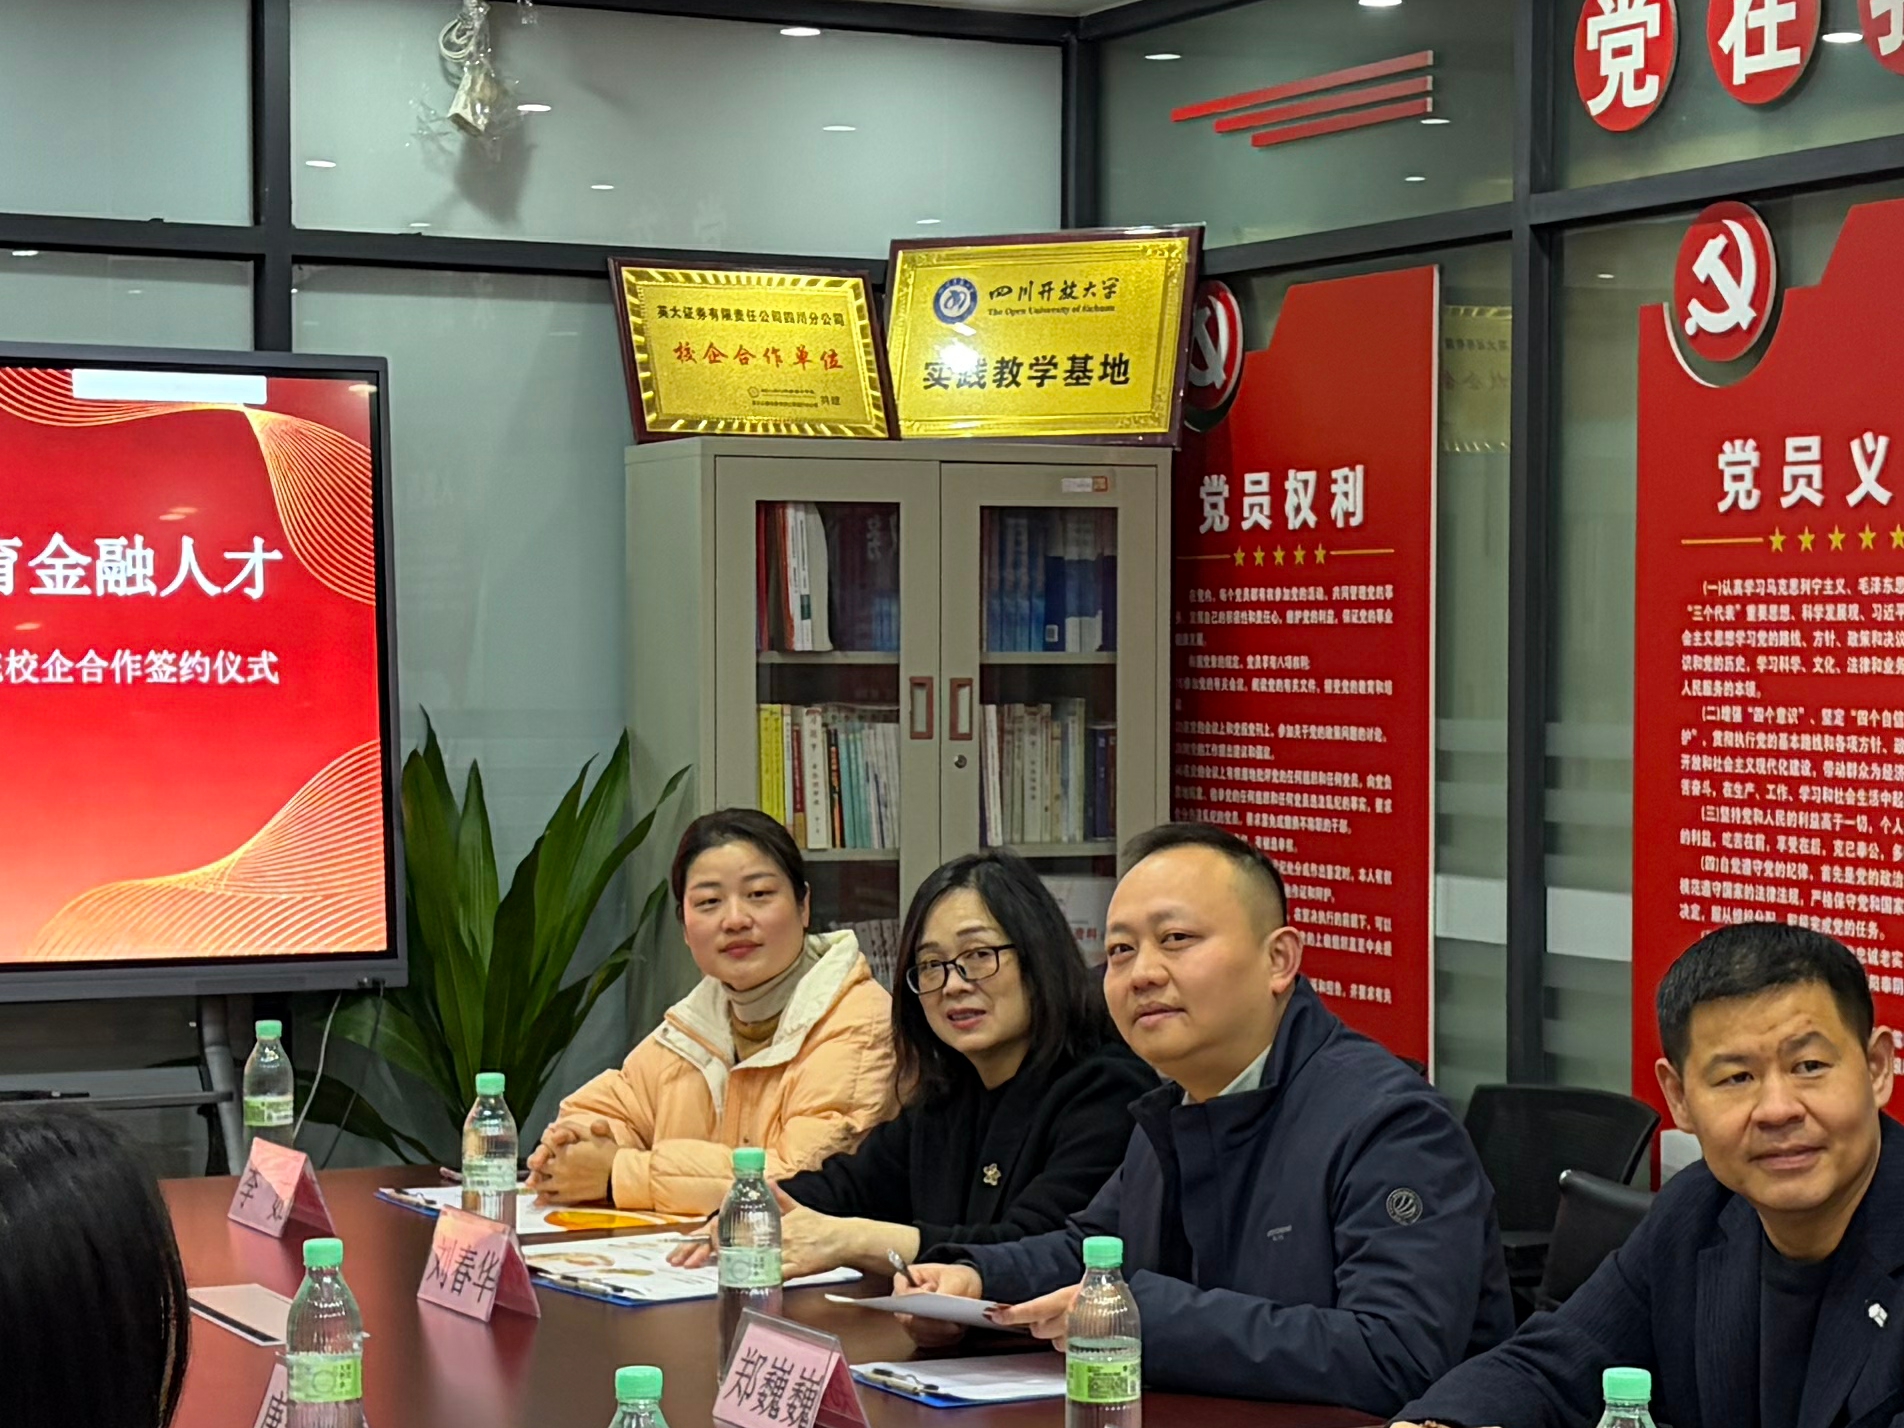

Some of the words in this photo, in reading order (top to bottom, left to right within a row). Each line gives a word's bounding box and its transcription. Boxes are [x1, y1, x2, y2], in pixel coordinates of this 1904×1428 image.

[989, 277, 1120, 302] 四川开放大学
[673, 341, 844, 371] 校企合作单位
[923, 353, 1131, 391] 实践教学基地
[1199, 464, 1365, 535] 党员权利
[426, 1234, 500, 1303] 刘春华
